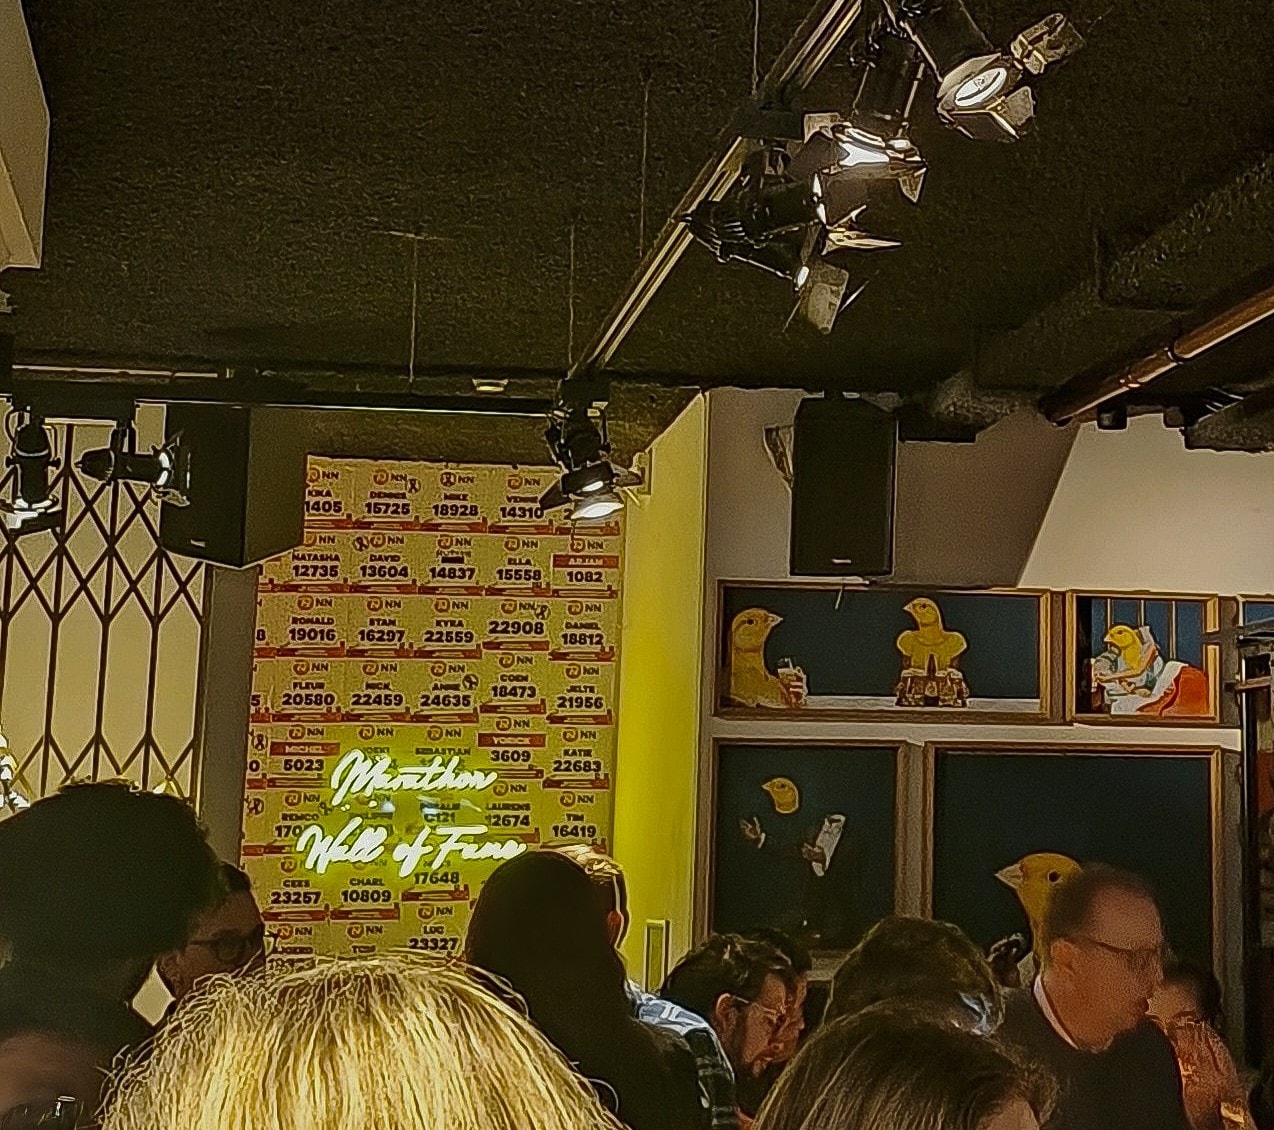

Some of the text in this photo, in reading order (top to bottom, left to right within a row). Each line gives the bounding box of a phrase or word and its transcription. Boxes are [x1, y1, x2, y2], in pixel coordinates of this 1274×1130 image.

[322, 471, 339, 480] NN
[391, 473, 407, 481] NN
[458, 476, 475, 484] NN
[524, 478, 541, 486] NN
[365, 502, 410, 515] 15725
[433, 504, 479, 516] 18928
[500, 507, 544, 519] 14310
[320, 535, 336, 544] NN
[388, 536, 405, 544] NN
[454, 538, 472, 547] NN
[521, 540, 539, 549] NN
[587, 541, 604, 550] NN
[292, 553, 341, 562] NATASHA
[369, 554, 401, 562] DAVID
[507, 558, 532, 566] ELLA
[293, 565, 339, 577] 12735
[360, 565, 408, 578] 13604
[429, 567, 476, 580] 14837
[497, 568, 542, 581] 15558
[567, 571, 603, 583] 1082
[316, 599, 333, 608] NN
[385, 600, 401, 608] NN
[452, 601, 469, 609] NN
[519, 603, 535, 611] NN
[585, 603, 602, 612] NN
[291, 617, 334, 625] RONALD
[488, 621, 544, 634] 22908
[289, 628, 336, 641] 19016
[424, 630, 474, 643] 22559
[561, 633, 604, 645] 18812
[517, 656, 534, 665] NN
[311, 663, 329, 671] NN
[381, 663, 398, 672] NN
[449, 664, 465, 673] NN
[582, 666, 599, 675] NN
[281, 693, 335, 706] 20580
[351, 693, 404, 706] 22459
[420, 695, 471, 707] 24635
[557, 696, 603, 709] 21956
[513, 720, 530, 728] NN
[307, 728, 324, 736] NN
[376, 728, 394, 737] NN
[445, 729, 462, 737] NN
[580, 731, 597, 739] NN
[491, 750, 531, 762] 3609
[283, 759, 324, 771] 5023
[553, 760, 601, 773] 22683
[331, 749, 498, 806] Marathon
[510, 784, 527, 792] NN
[303, 794, 320, 802] NN
[577, 795, 594, 803] NN
[566, 813, 584, 822] TIM
[553, 825, 597, 837] 16419
[296, 817, 527, 877] Wall of Fame
[414, 872, 460, 885] 17648
[271, 891, 321, 904] 23257
[341, 889, 391, 903] 10809
[435, 907, 453, 916] NN
[294, 927, 313, 936] NN
[365, 926, 383, 935] NN
[409, 938, 458, 951] 23327
